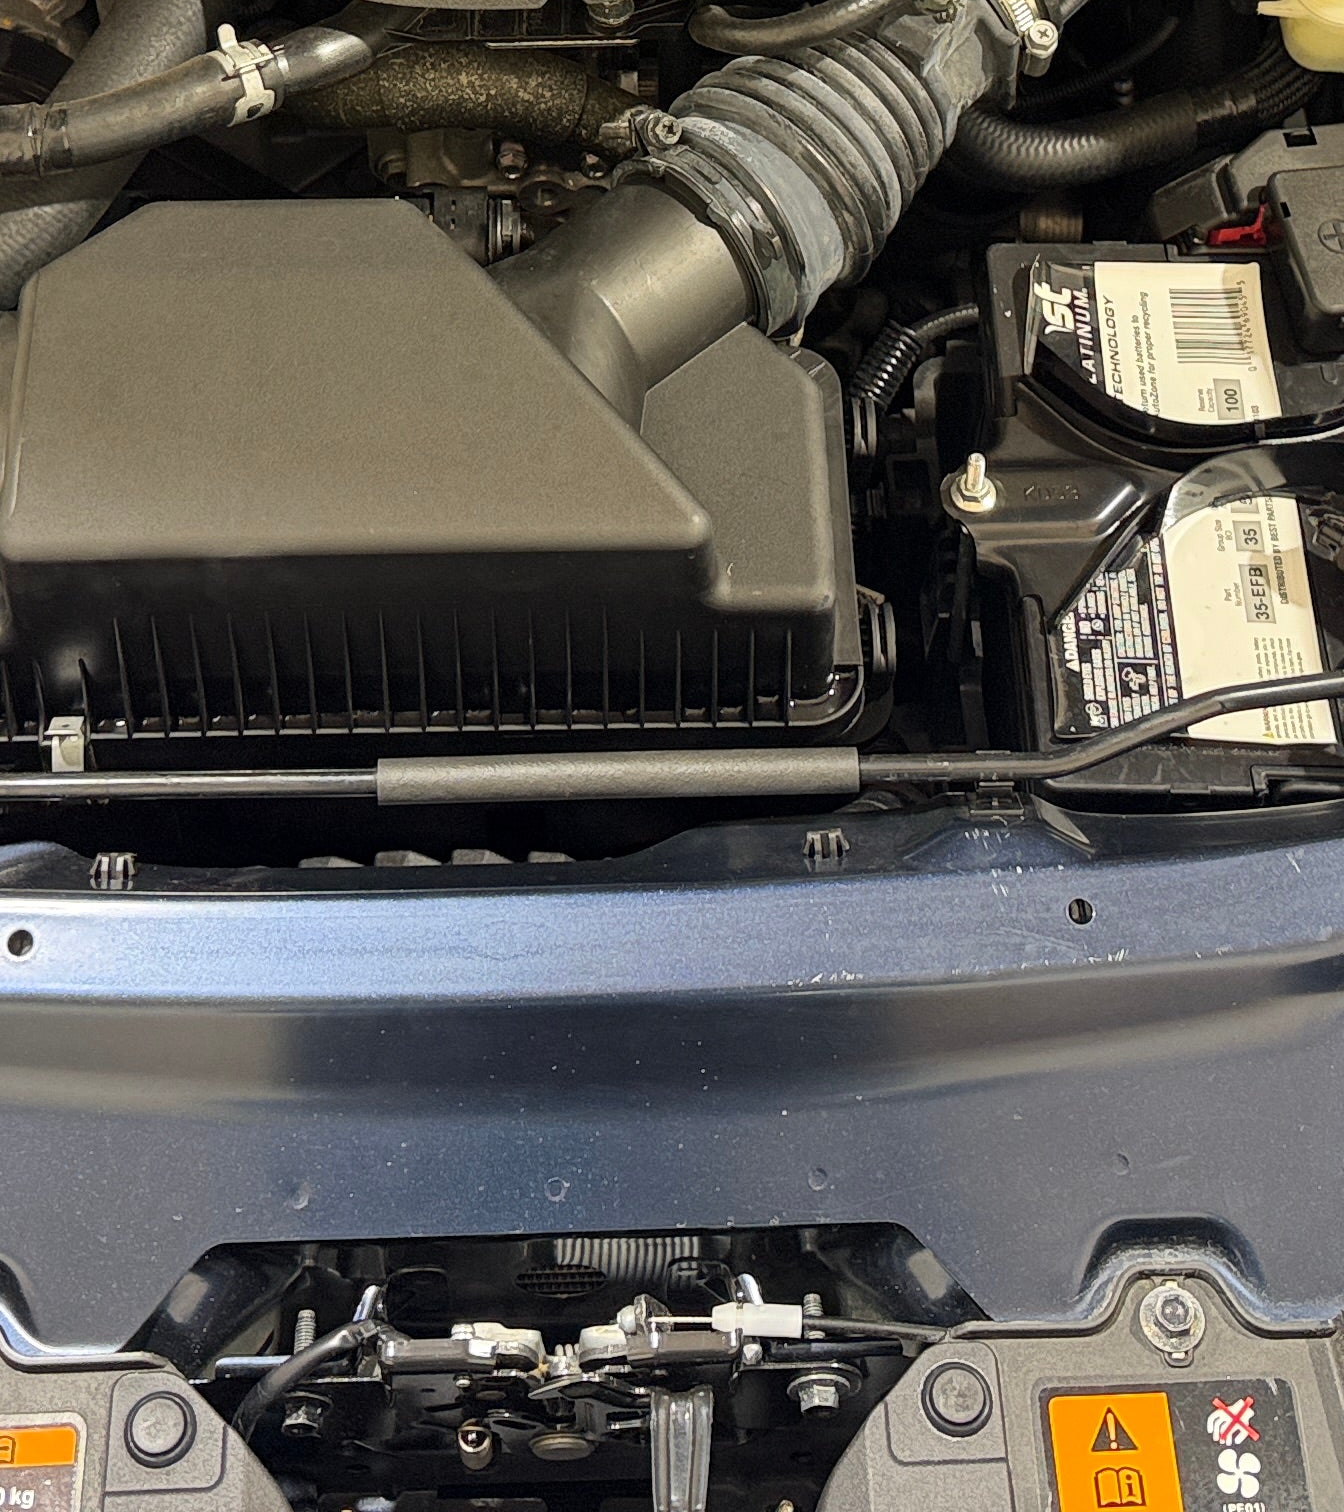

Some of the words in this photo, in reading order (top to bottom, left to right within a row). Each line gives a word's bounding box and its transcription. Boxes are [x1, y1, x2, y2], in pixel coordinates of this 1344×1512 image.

[1138, 291, 1150, 330] recycling
[1072, 287, 1098, 386] LATINUM
[1131, 326, 1143, 364] batteries
[1143, 332, 1156, 361] proper
[1136, 365, 1146, 387] used
[1146, 361, 1156, 375] for
[1148, 376, 1160, 415] utoZone
[1223, 388, 1239, 413] 100
[1242, 528, 1259, 546] 35
[1268, 523, 1279, 542] BEST
[1248, 567, 1270, 620] 35-EFB
[1273, 556, 1290, 605] DISTRIBUTED
[1061, 611, 1079, 663] DANGE
[8, 1486, 36, 1510] kg
